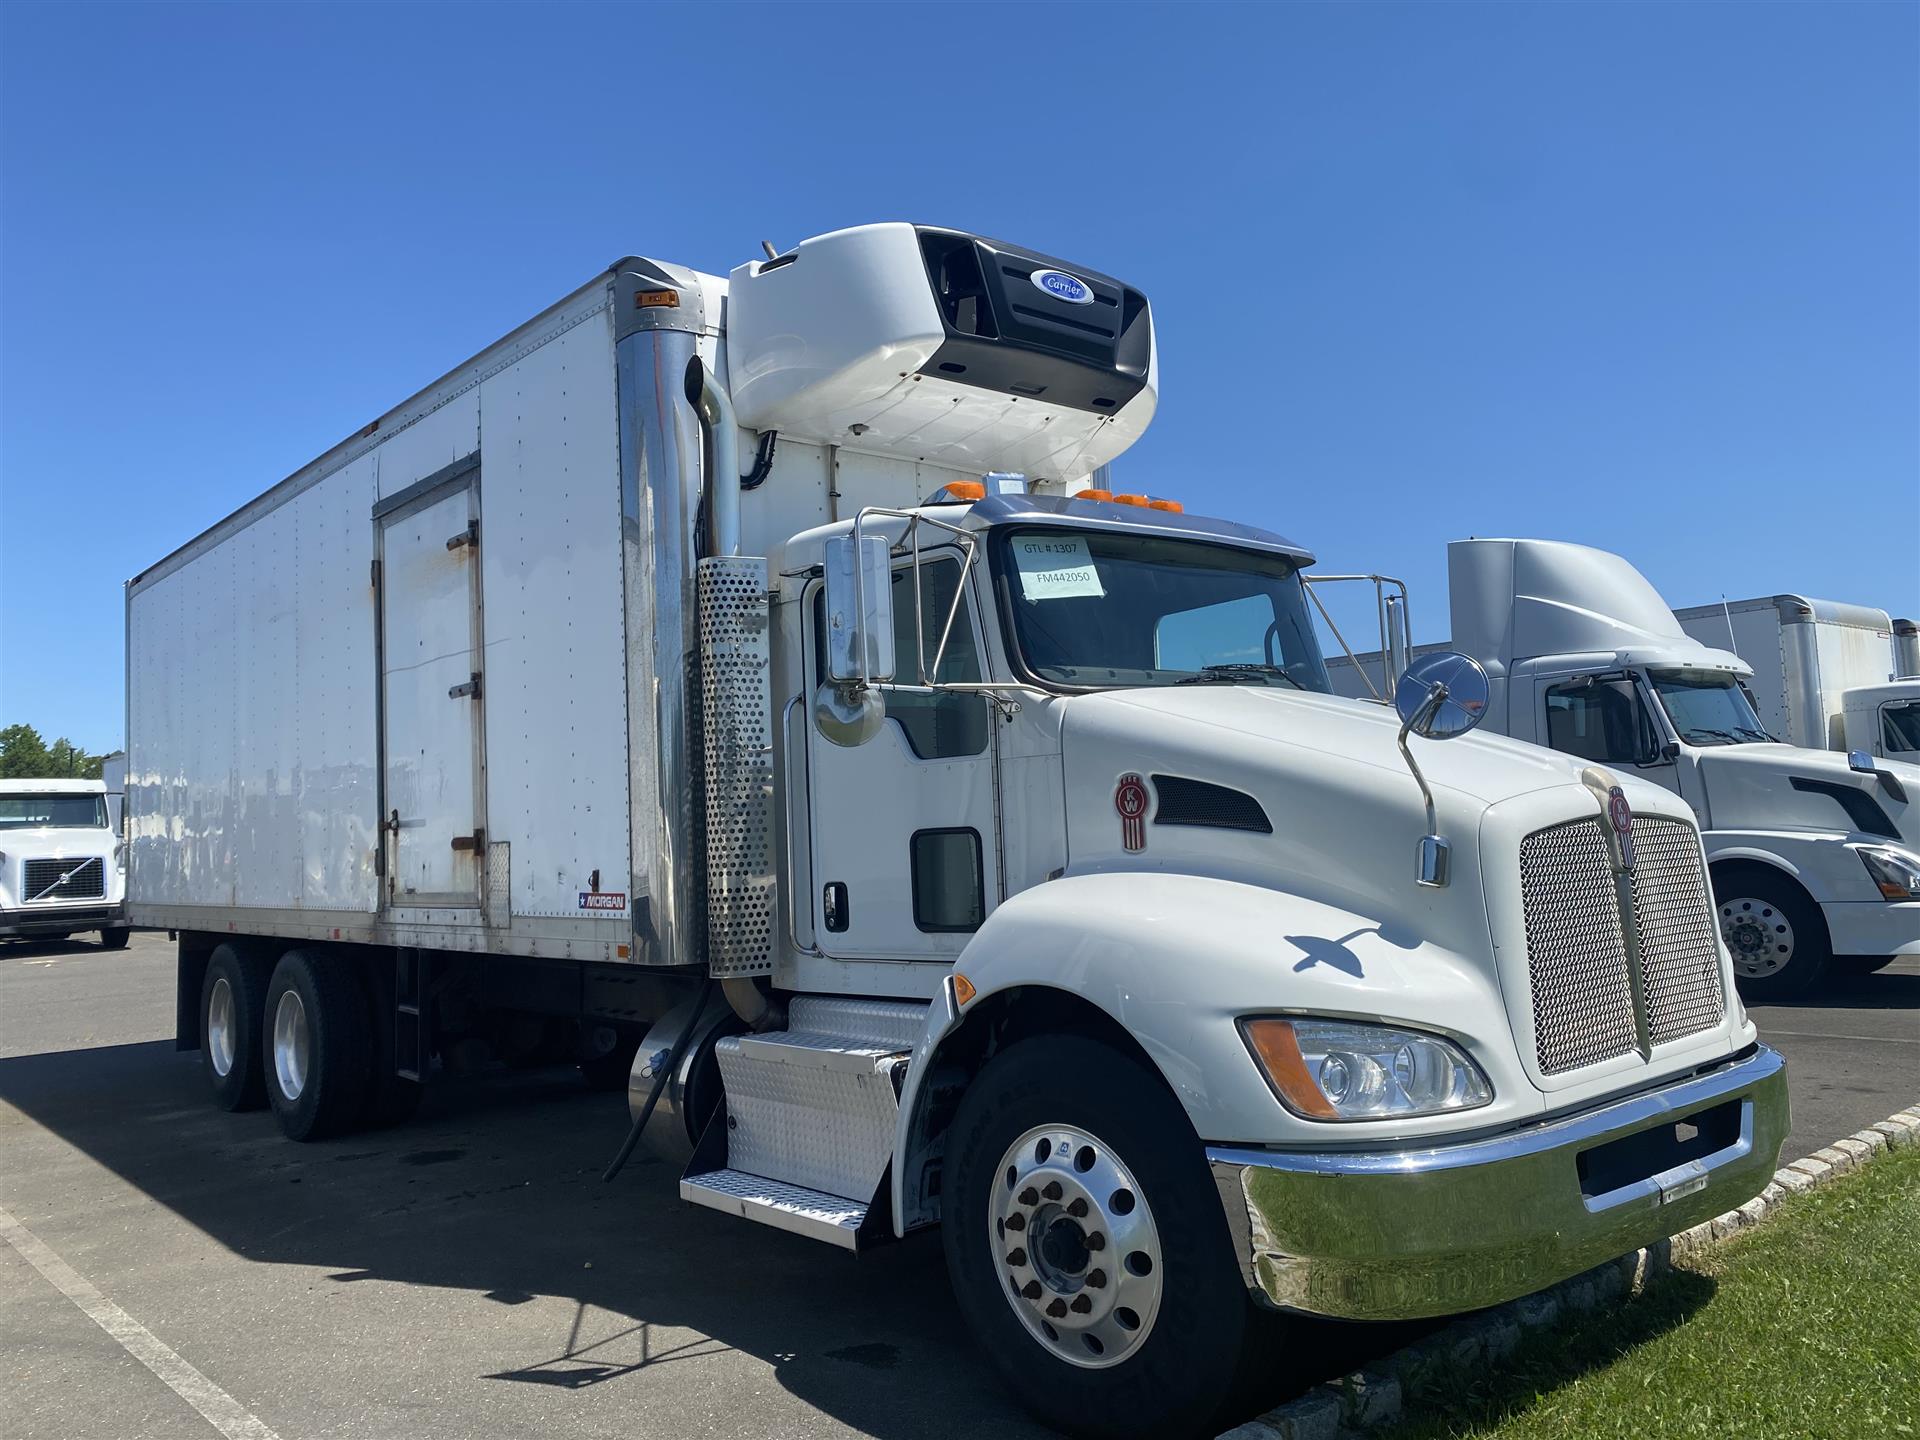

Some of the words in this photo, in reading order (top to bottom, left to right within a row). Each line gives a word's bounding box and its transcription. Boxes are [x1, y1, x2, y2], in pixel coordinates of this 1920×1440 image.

[1047, 277, 1081, 295] Carrier
[1024, 543, 1043, 554] GTL
[1045, 543, 1052, 553] #
[1054, 543, 1077, 553] 1307
[1036, 572, 1090, 583] FM442050
[586, 895, 624, 908] MORGAN
